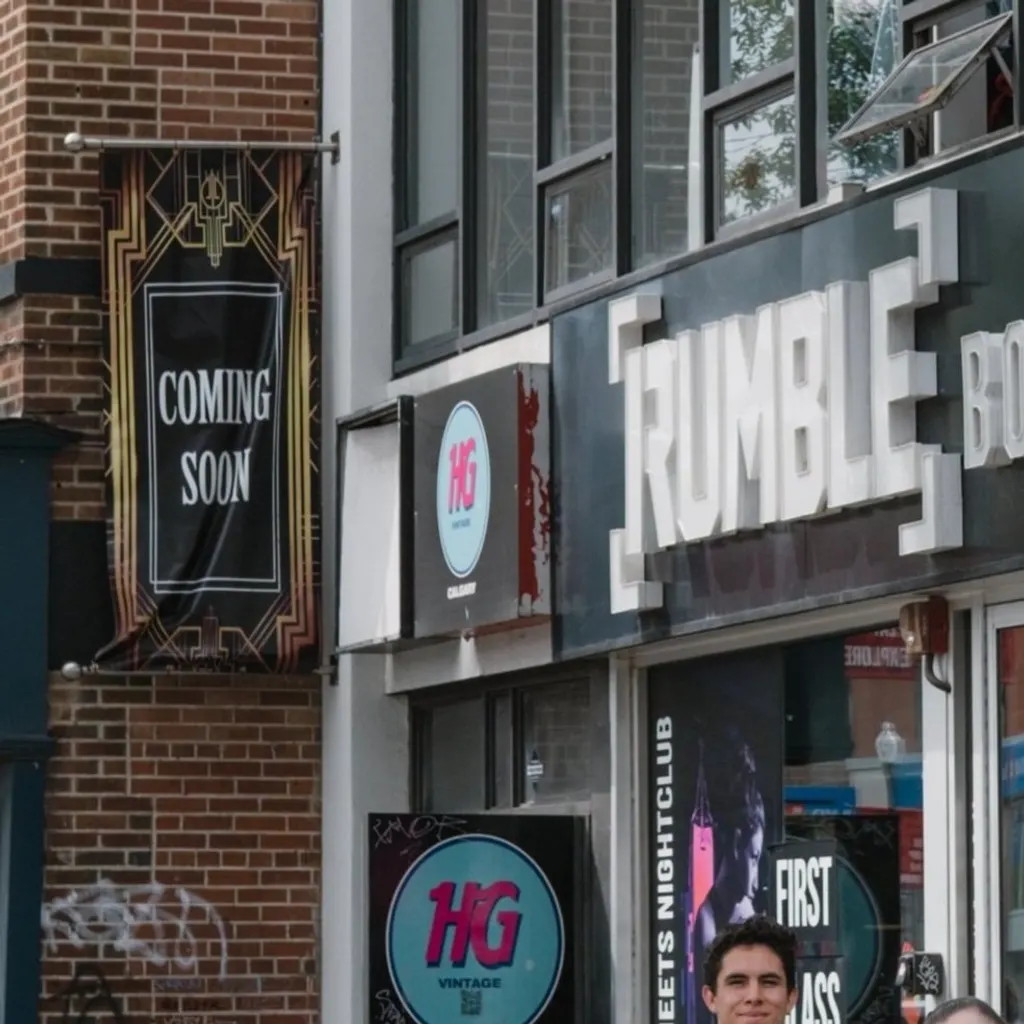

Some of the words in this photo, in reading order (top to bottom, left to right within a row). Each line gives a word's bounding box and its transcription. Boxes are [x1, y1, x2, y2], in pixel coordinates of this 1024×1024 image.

[159, 368, 272, 426] COMING
[624, 257, 940, 555] RUMBLE
[180, 448, 252, 505] SOON
[656, 715, 674, 920] NIGHTCLUB
[425, 880, 523, 970] HG
[776, 856, 833, 928] FIRST
[438, 977, 502, 989] VINTAGE
